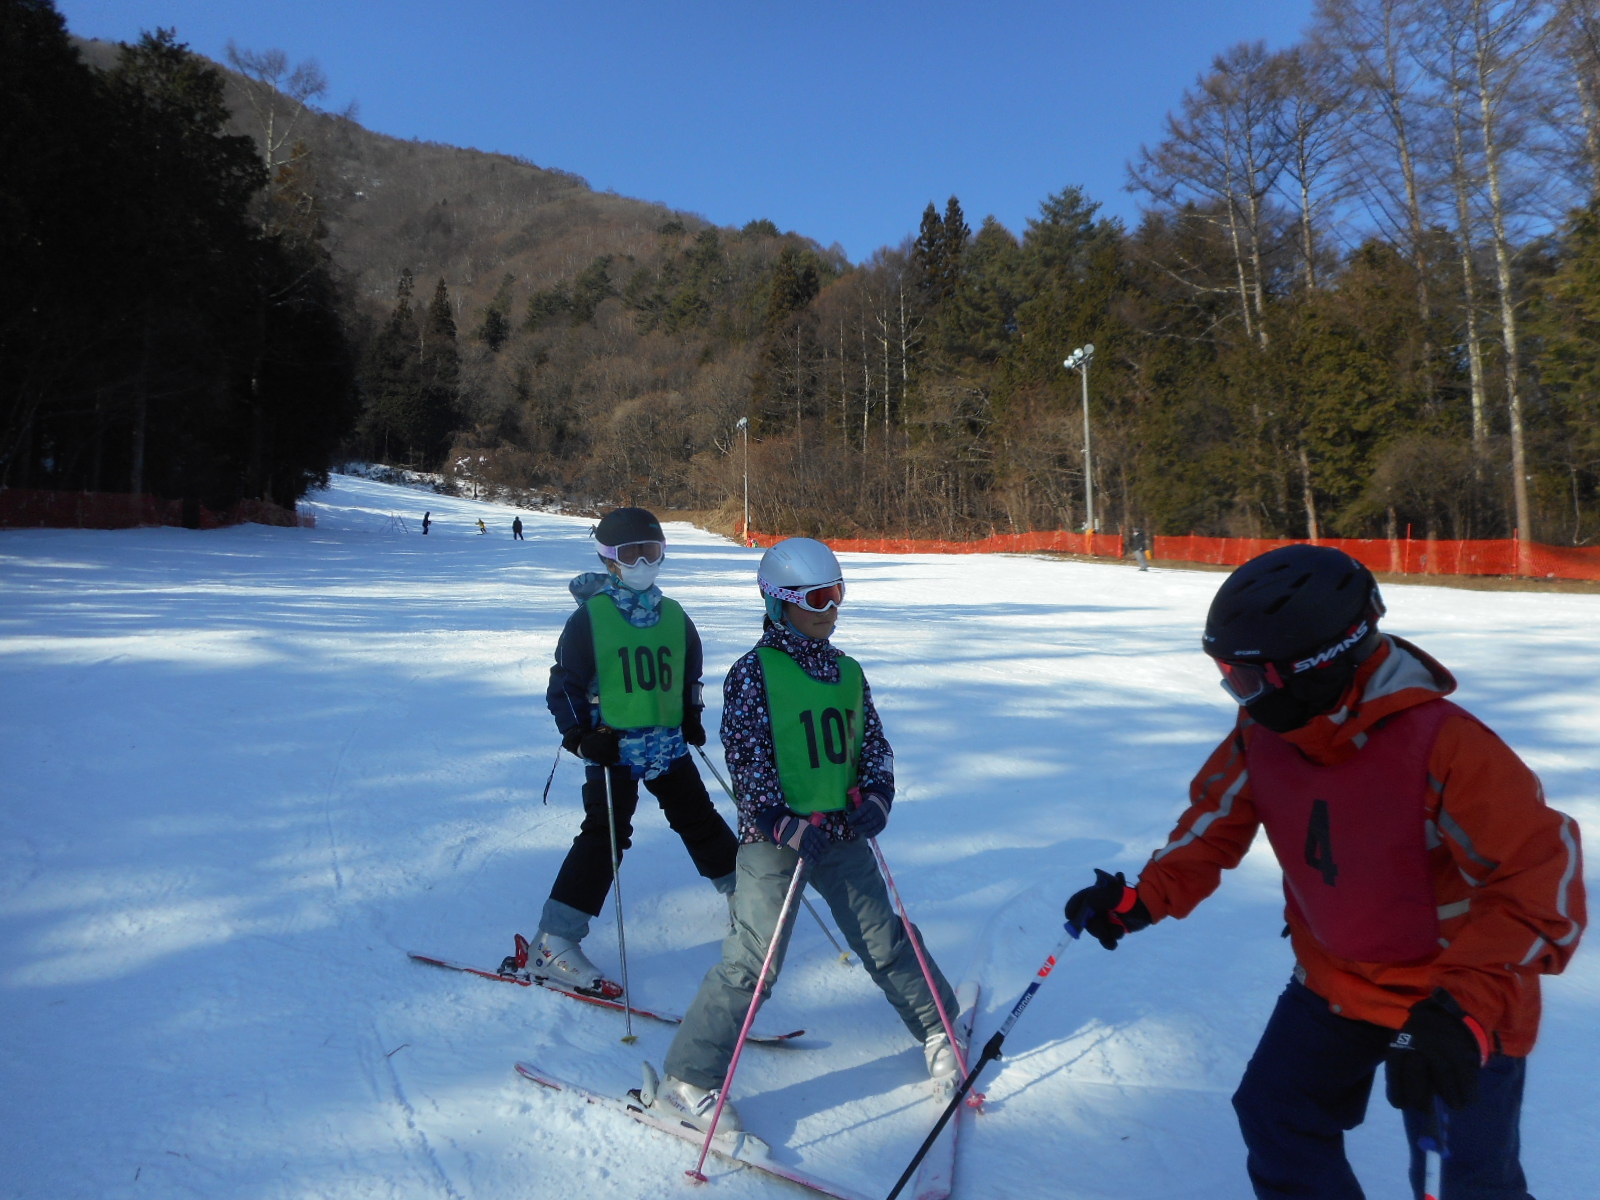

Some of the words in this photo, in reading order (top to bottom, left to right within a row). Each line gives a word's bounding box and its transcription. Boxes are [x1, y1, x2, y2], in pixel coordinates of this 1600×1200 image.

[618, 646, 672, 693] 106
[1293, 620, 1368, 673] SWANS
[1305, 799, 1338, 888] 4
